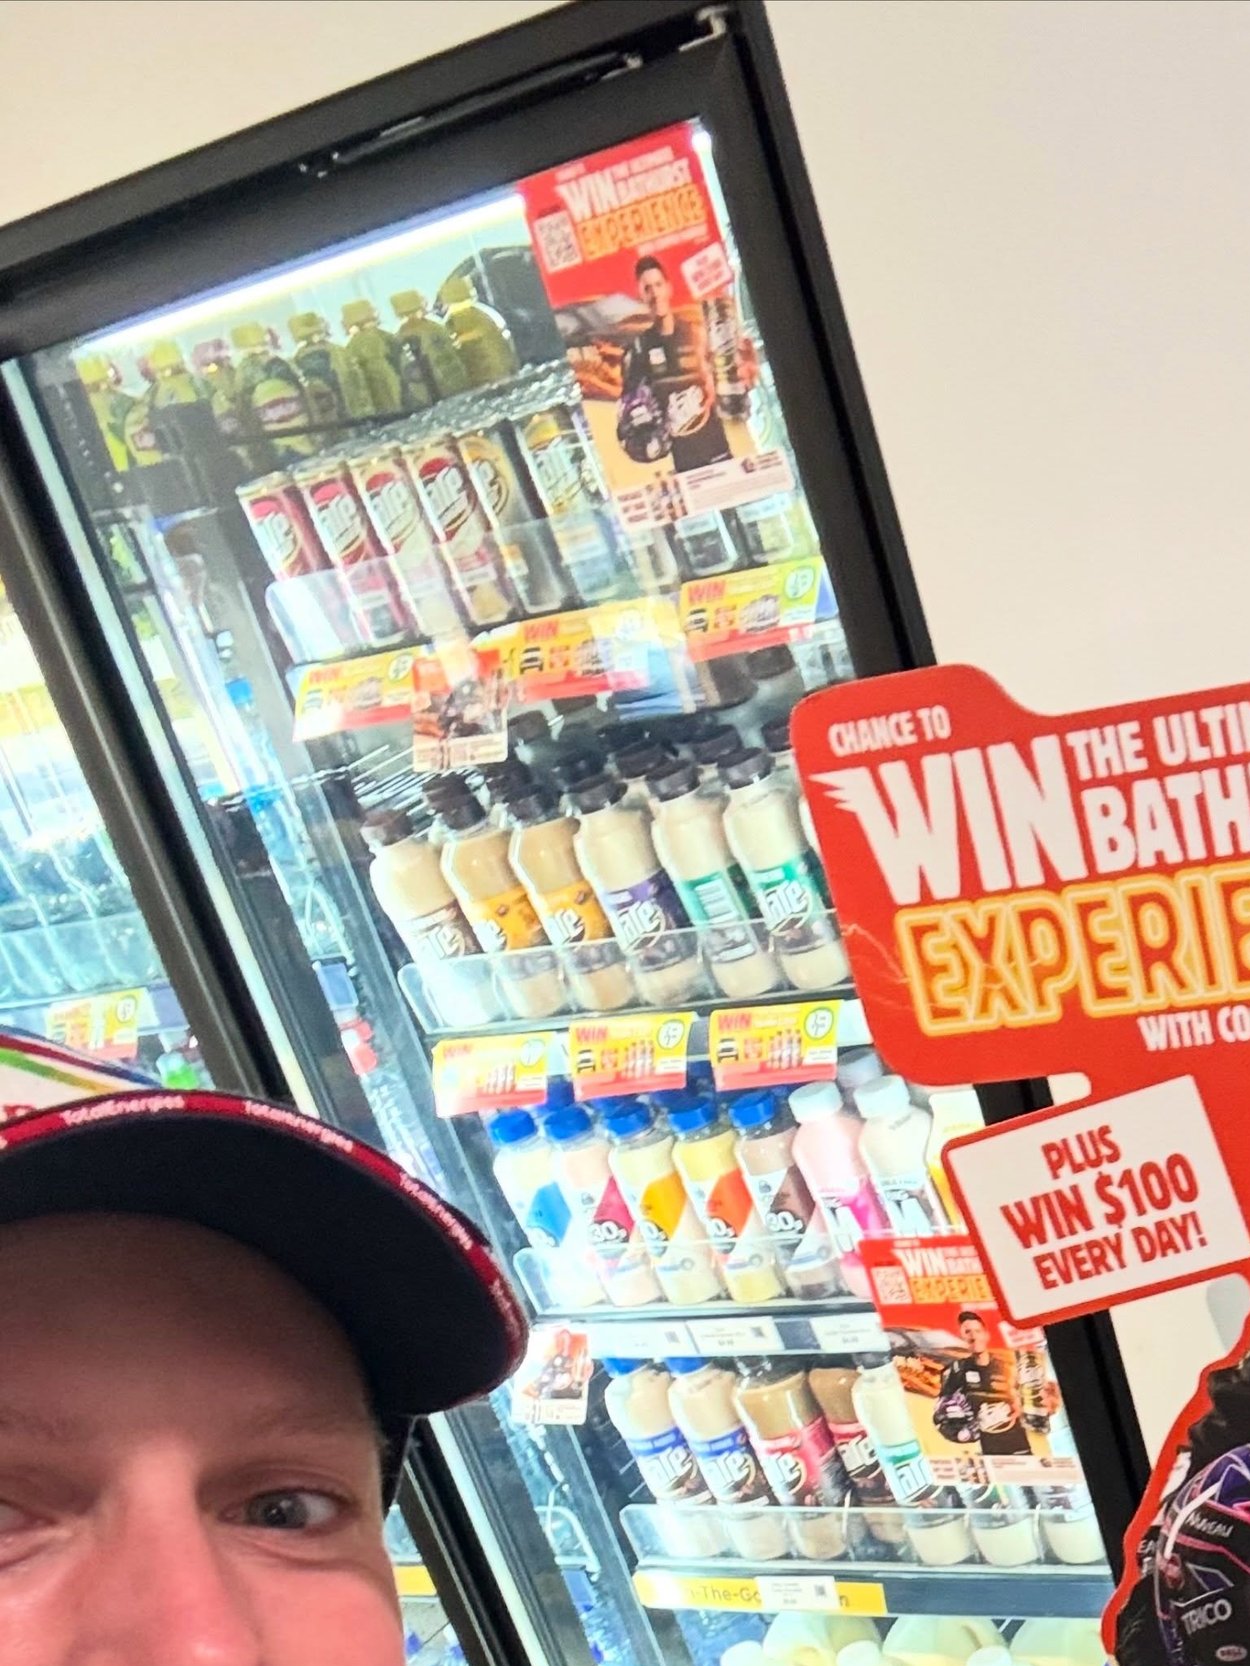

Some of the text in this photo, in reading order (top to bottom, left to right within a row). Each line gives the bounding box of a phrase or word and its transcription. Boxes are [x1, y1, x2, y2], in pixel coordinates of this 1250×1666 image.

[828, 705, 951, 757] CHANCE TO
[1066, 723, 1149, 781] THE
[810, 735, 1086, 905] WIN
[717, 1013, 752, 1030] WIN
[1137, 1010, 1214, 1051] WITH
[1042, 1123, 1122, 1180] PLUS
[1000, 1153, 1199, 1250] WIN $100
[1033, 1211, 1209, 1292] EVERY DAY!
[1180, 1598, 1233, 1636] TRICO
